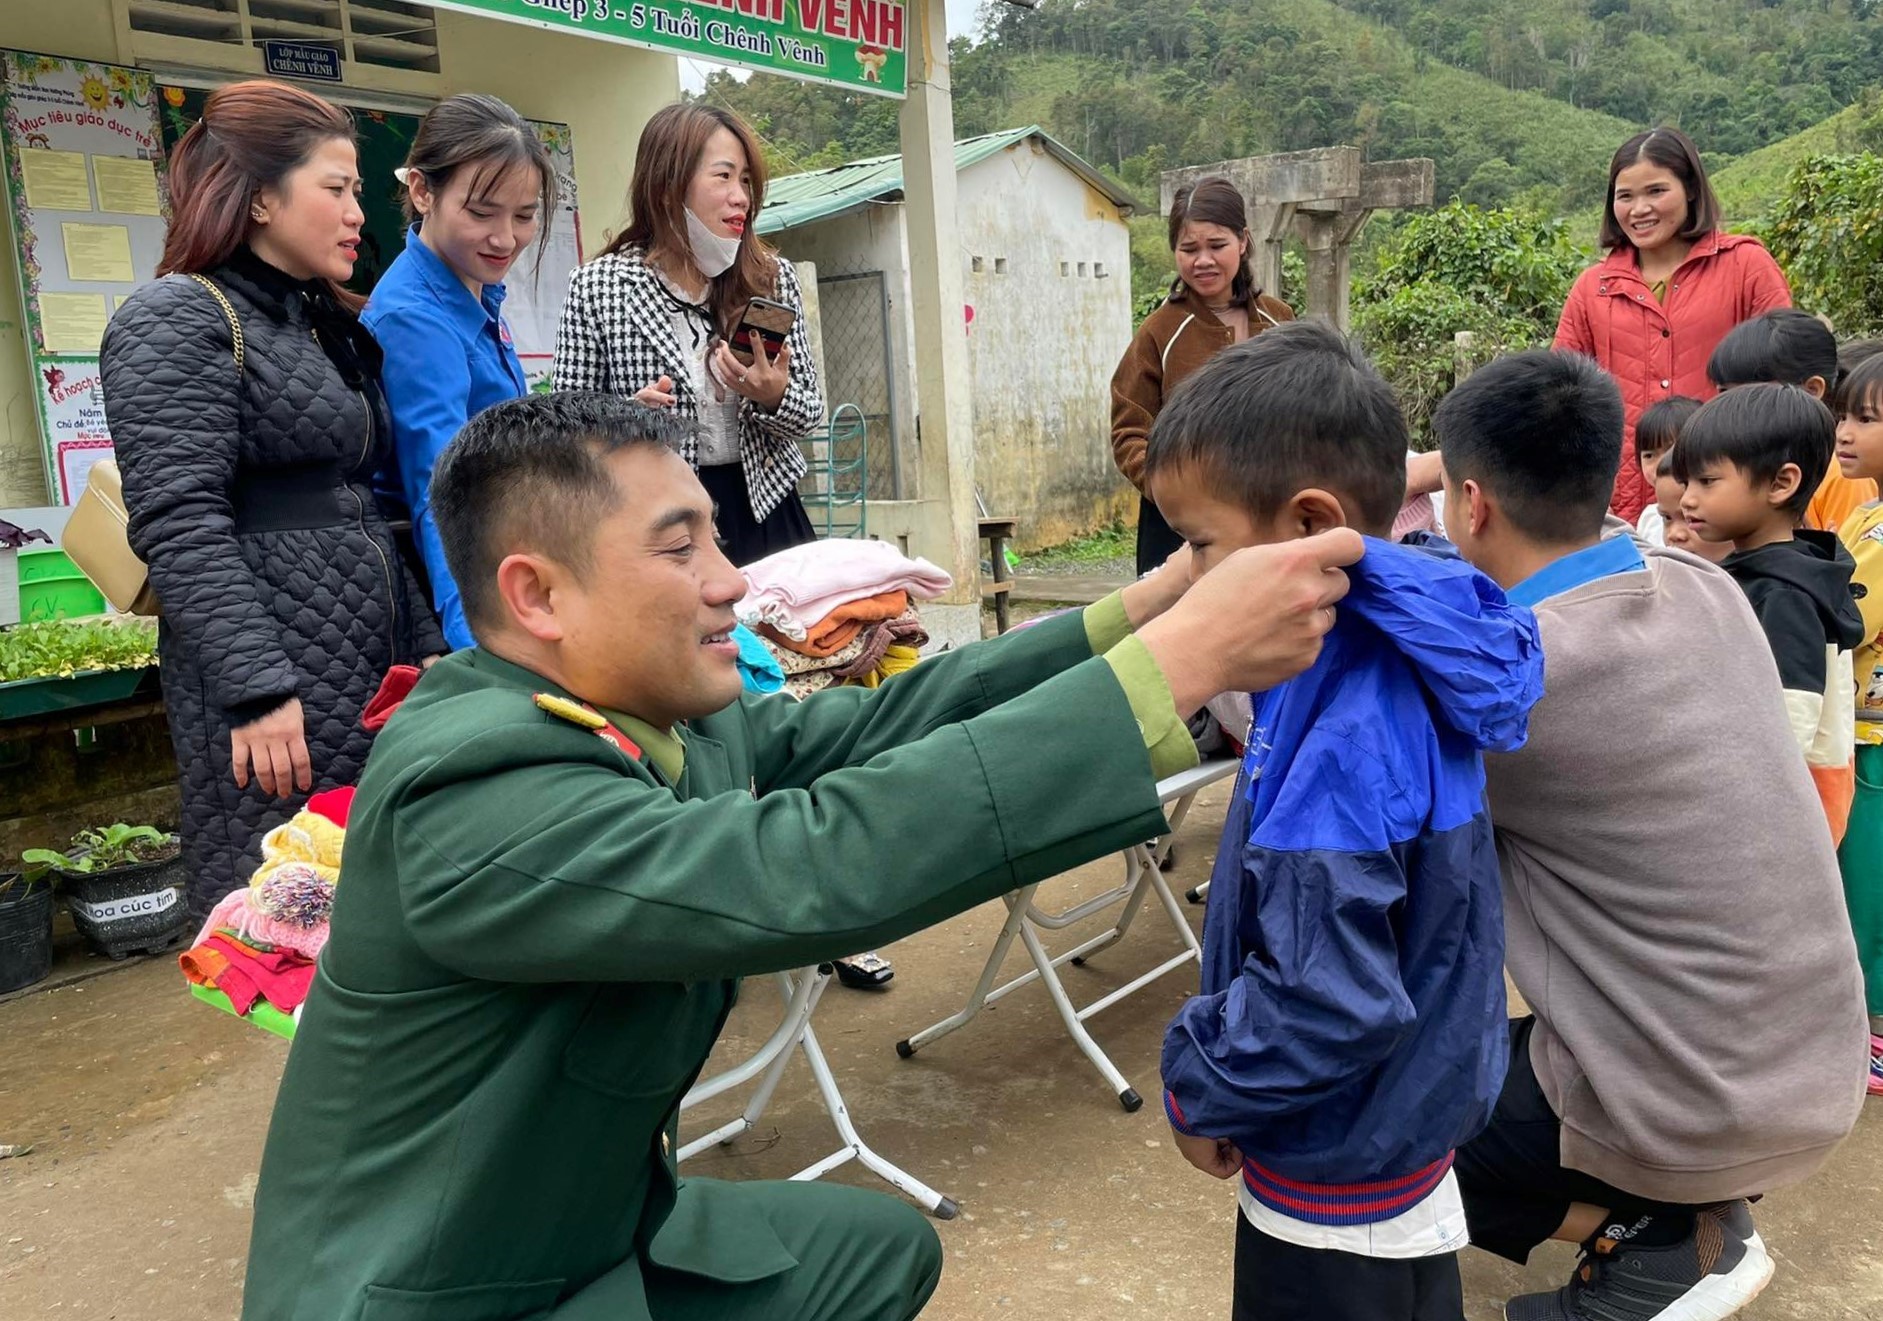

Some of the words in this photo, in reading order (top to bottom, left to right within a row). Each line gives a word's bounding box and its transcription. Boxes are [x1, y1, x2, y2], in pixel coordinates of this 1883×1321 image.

[595, 0, 608, 19] 3
[632, 5, 645, 27] 5
[651, 8, 699, 38] Tuổi
[707, 22, 772, 53] Chênh
[776, 37, 825, 65] Vênh
[274, 58, 306, 72] CHÊNH
[307, 61, 333, 75] VÊNH
[18, 116, 46, 133] Mục
[47, 110, 73, 124] tiêu
[76, 111, 104, 126] giáo
[107, 118, 132, 137] dục
[64, 376, 94, 397] hoạch
[120, 899, 152, 914] cúc
[156, 891, 174, 908] tím
